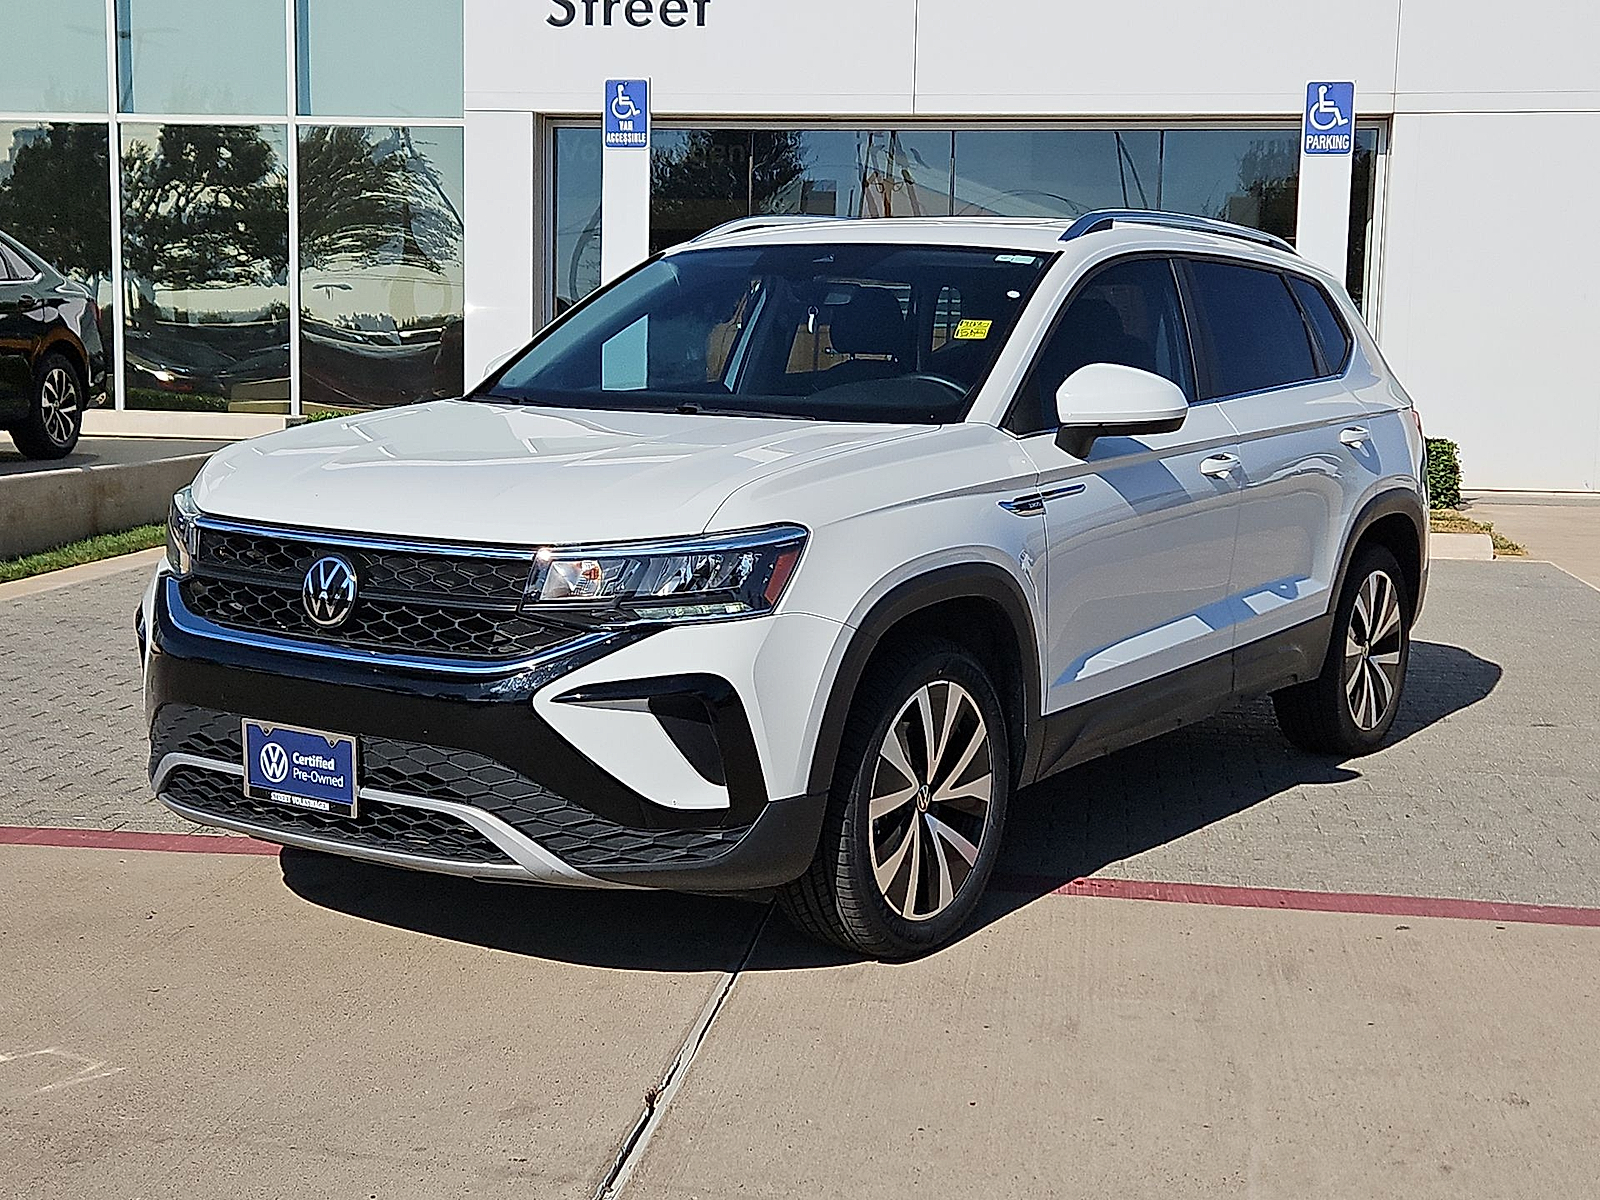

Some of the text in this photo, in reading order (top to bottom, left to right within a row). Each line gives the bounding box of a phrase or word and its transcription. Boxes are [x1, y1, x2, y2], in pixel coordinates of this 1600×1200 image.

[545, 0, 711, 27] Street
[1306, 135, 1350, 150] PARKING
[292, 752, 335, 771] Certified
[293, 767, 344, 788] Pre-Owned
